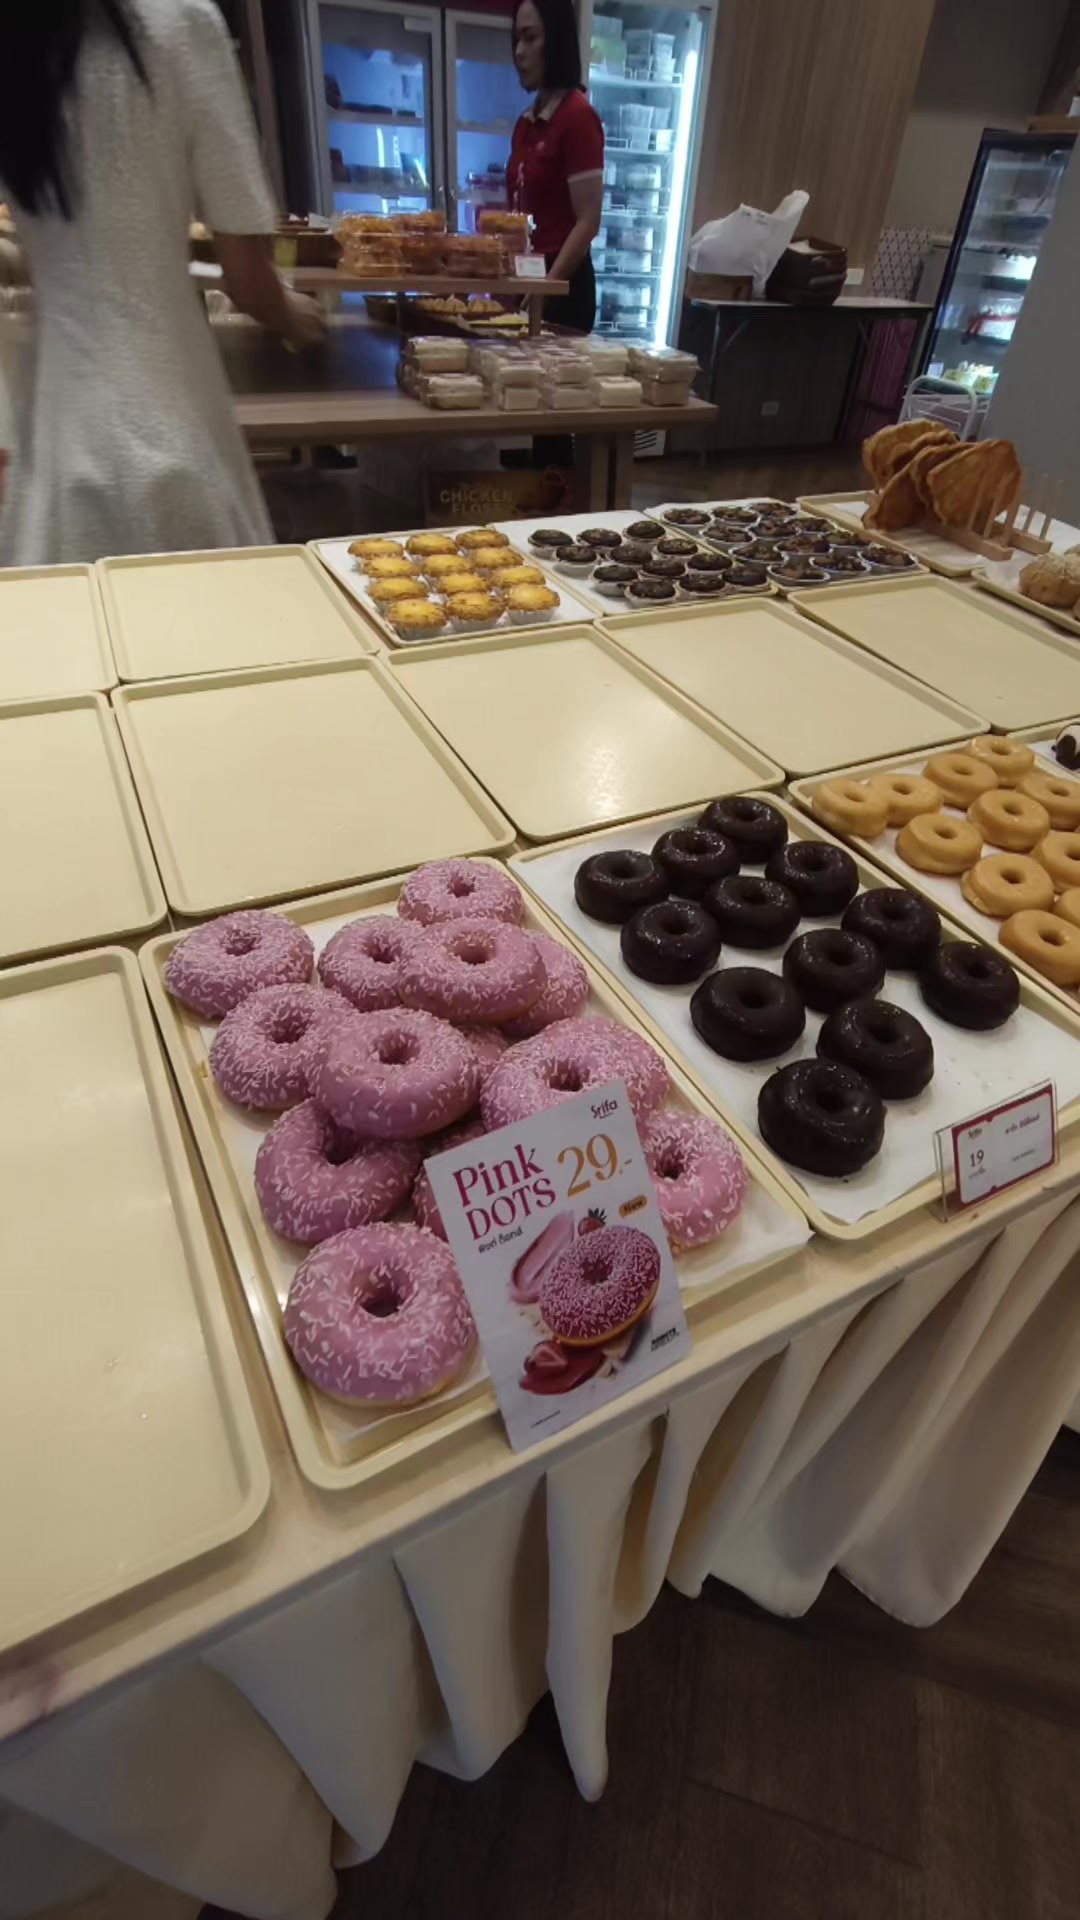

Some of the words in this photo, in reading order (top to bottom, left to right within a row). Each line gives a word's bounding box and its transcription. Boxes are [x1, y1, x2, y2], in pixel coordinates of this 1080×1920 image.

[452, 1144, 545, 1208] Pink
[969, 1149, 985, 1168] 19
[465, 1177, 557, 1241] DOTS
[623, 1199, 646, 1214] New
